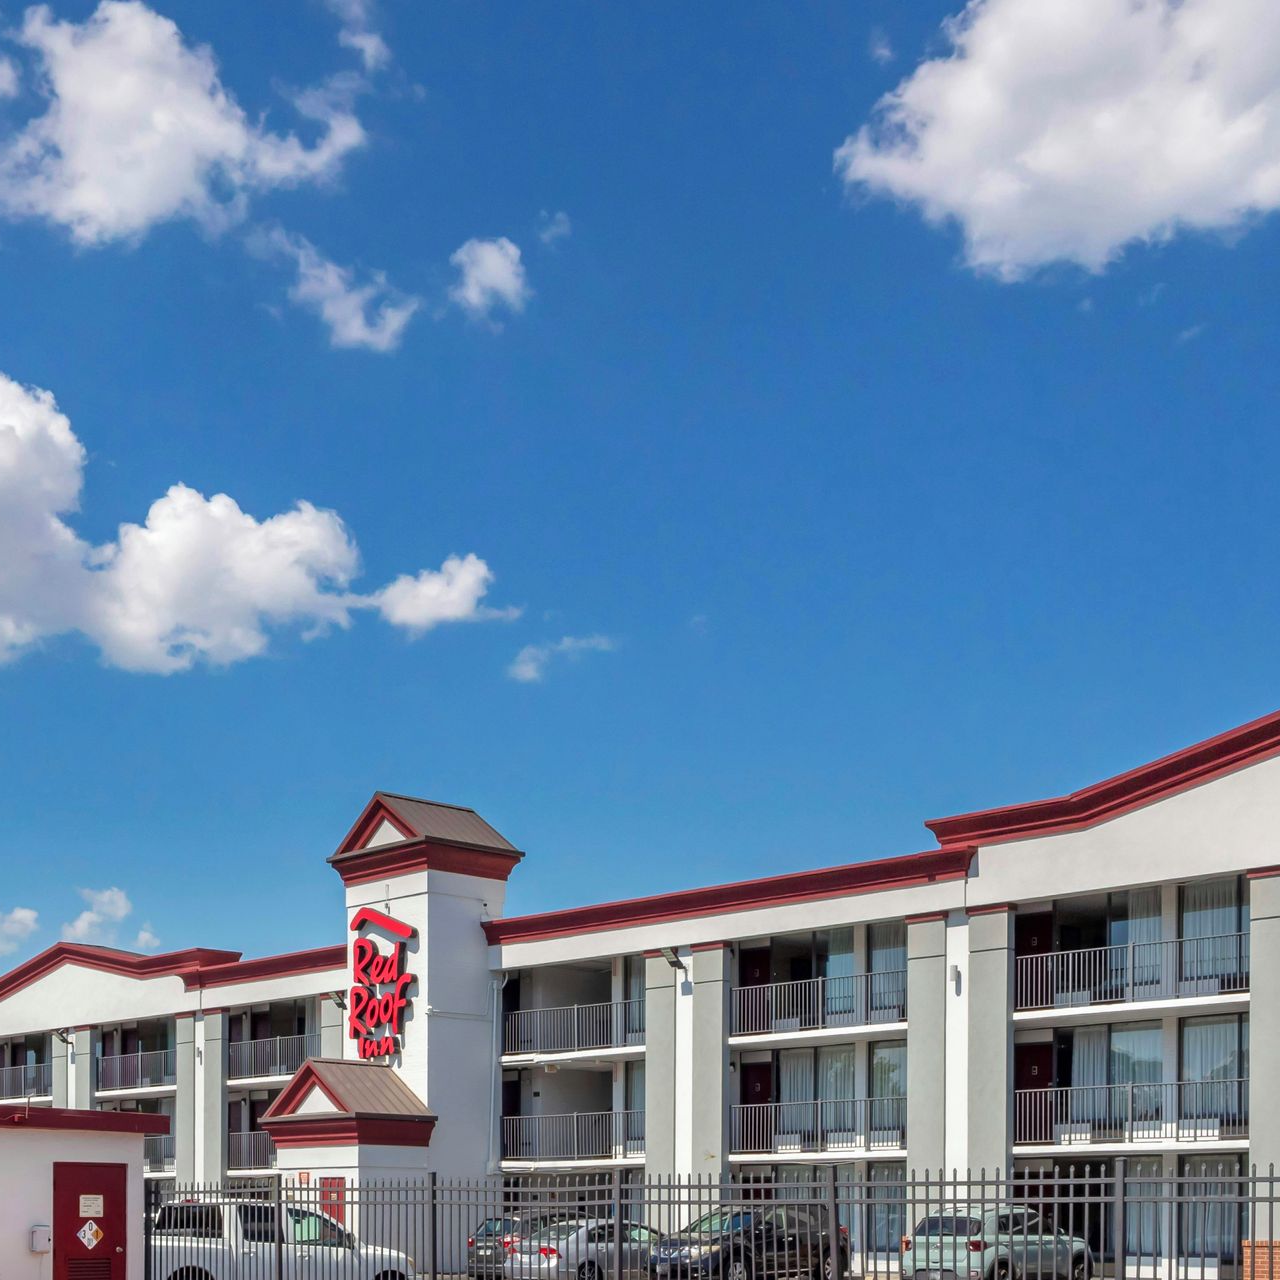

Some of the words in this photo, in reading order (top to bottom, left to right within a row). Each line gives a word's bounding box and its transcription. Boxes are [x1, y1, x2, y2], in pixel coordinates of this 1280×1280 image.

[353, 937, 400, 986] Red
[348, 972, 412, 1040] Roof
[357, 1035, 395, 1059] Inn
